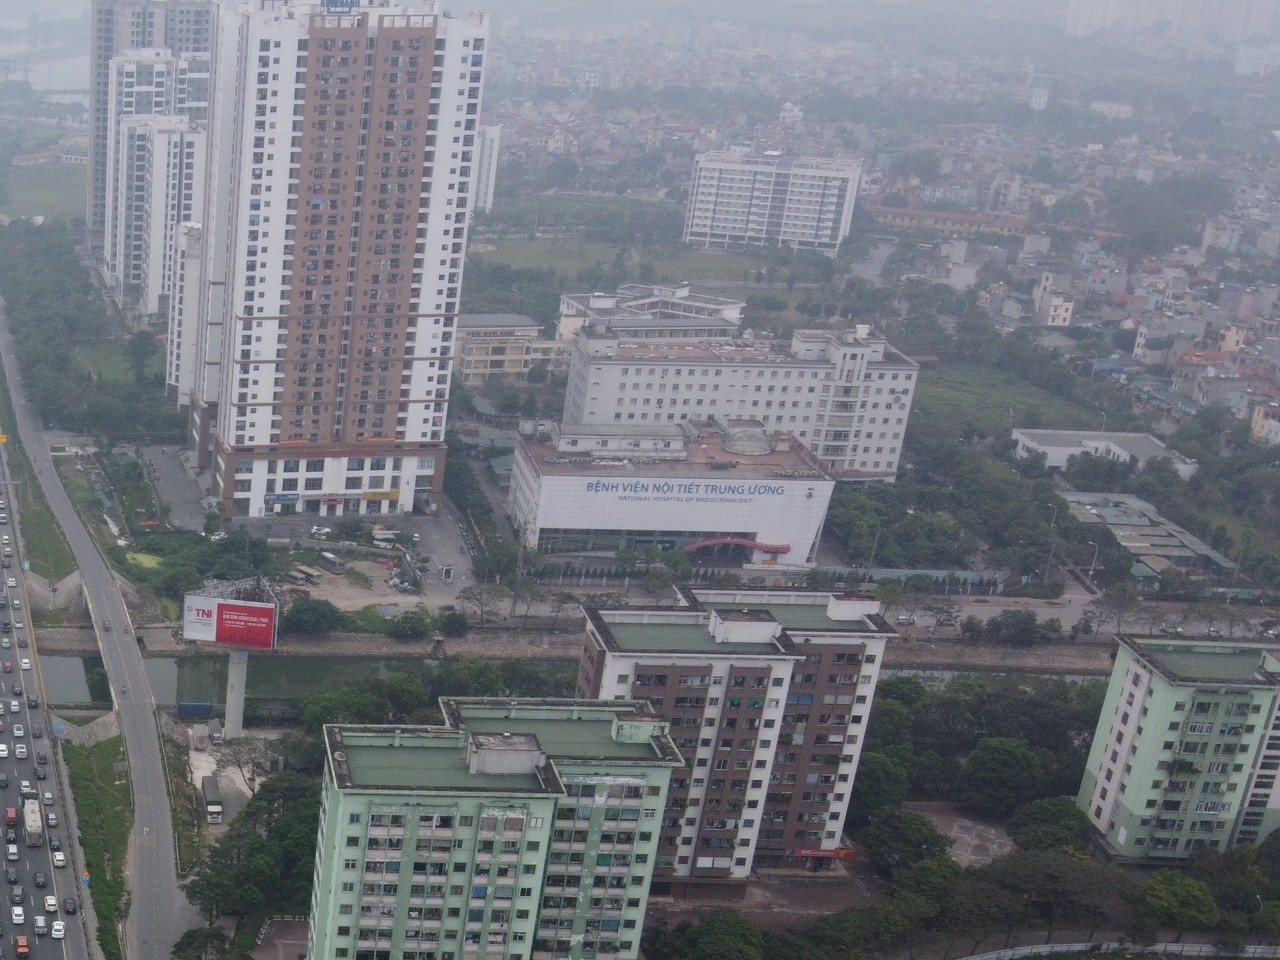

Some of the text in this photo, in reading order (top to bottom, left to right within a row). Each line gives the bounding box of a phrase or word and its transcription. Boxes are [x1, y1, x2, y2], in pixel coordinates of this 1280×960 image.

[586, 480, 785, 496] BỆNH VIỆN NỘI TIẾT TRUNG ƯƠNG
[195, 608, 212, 618] TNI
